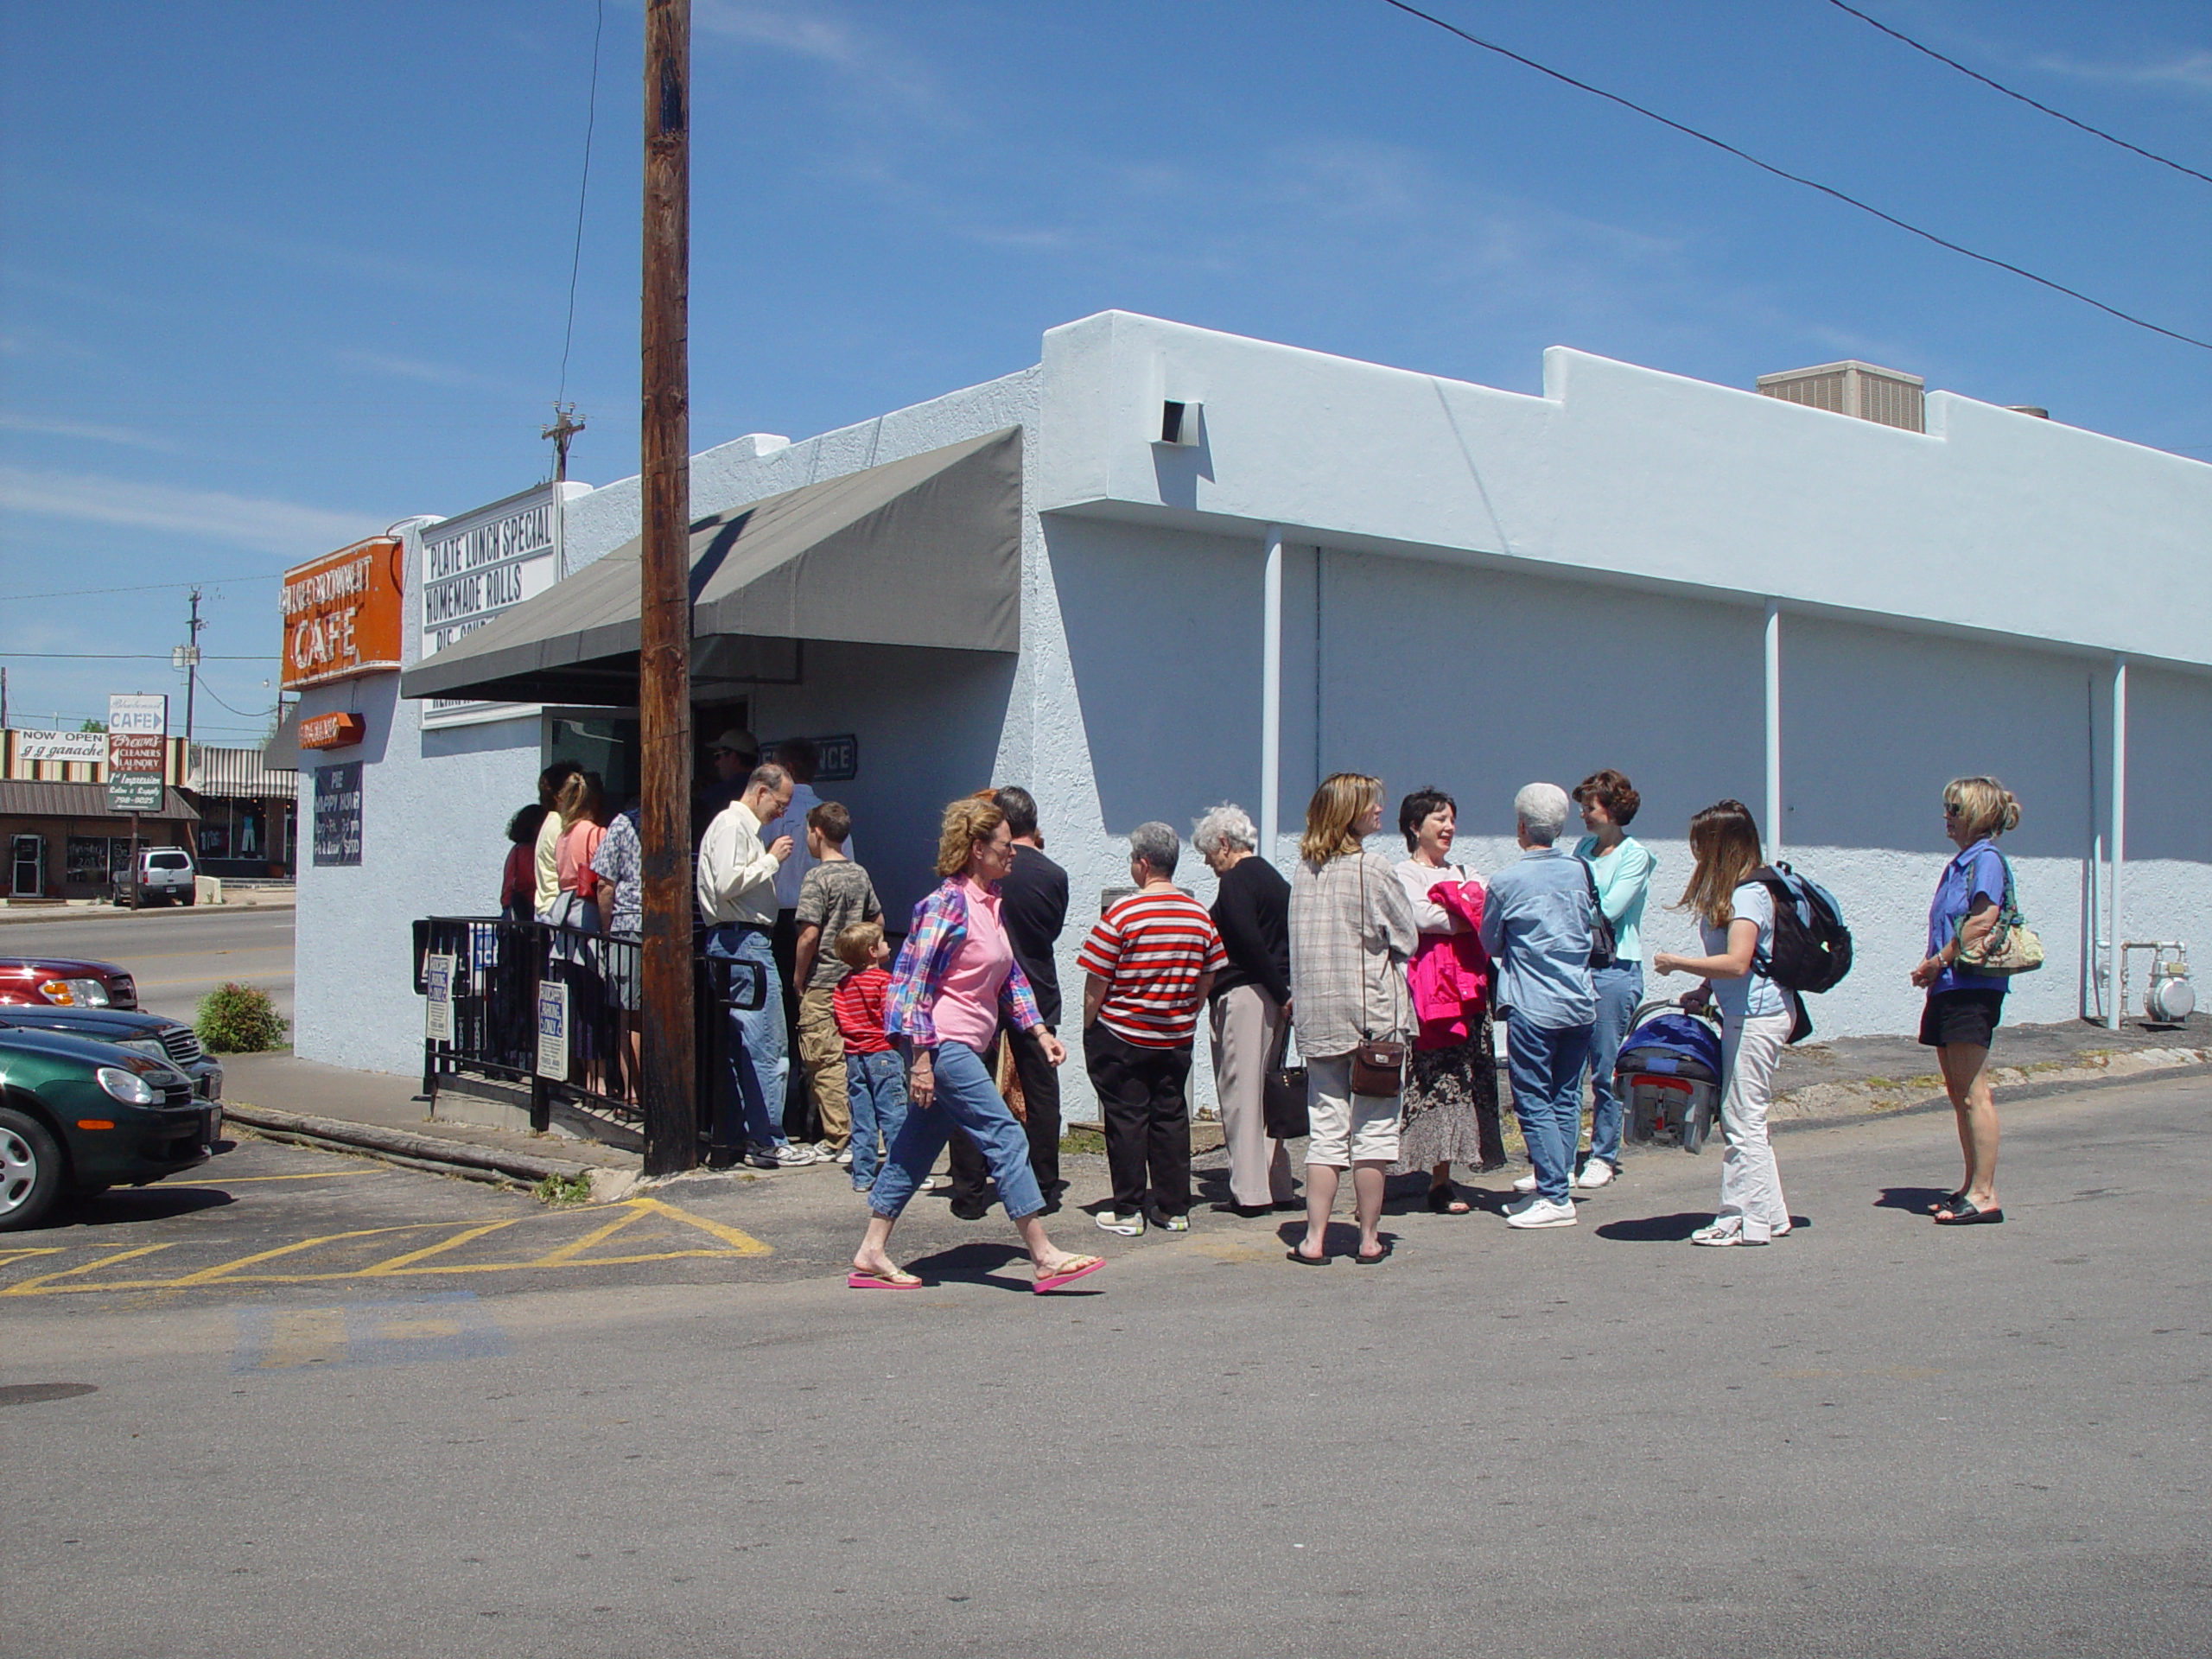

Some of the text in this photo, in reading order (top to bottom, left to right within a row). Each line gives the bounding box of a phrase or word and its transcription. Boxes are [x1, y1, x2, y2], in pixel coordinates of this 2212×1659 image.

[431, 505, 552, 579] PLATE LUNCH SPECIAL
[426, 564, 522, 625] HOMEMADE ROLLS
[290, 607, 356, 669] CAFE
[111, 712, 152, 728] CAFE
[23, 731, 103, 742] NOW OPEN
[111, 734, 162, 747] Brown's
[46, 743, 104, 758] ganache
[119, 748, 161, 758] CLEANERS
[331, 770, 344, 790] PIE
[315, 791, 360, 813] HAPPY HOUR
